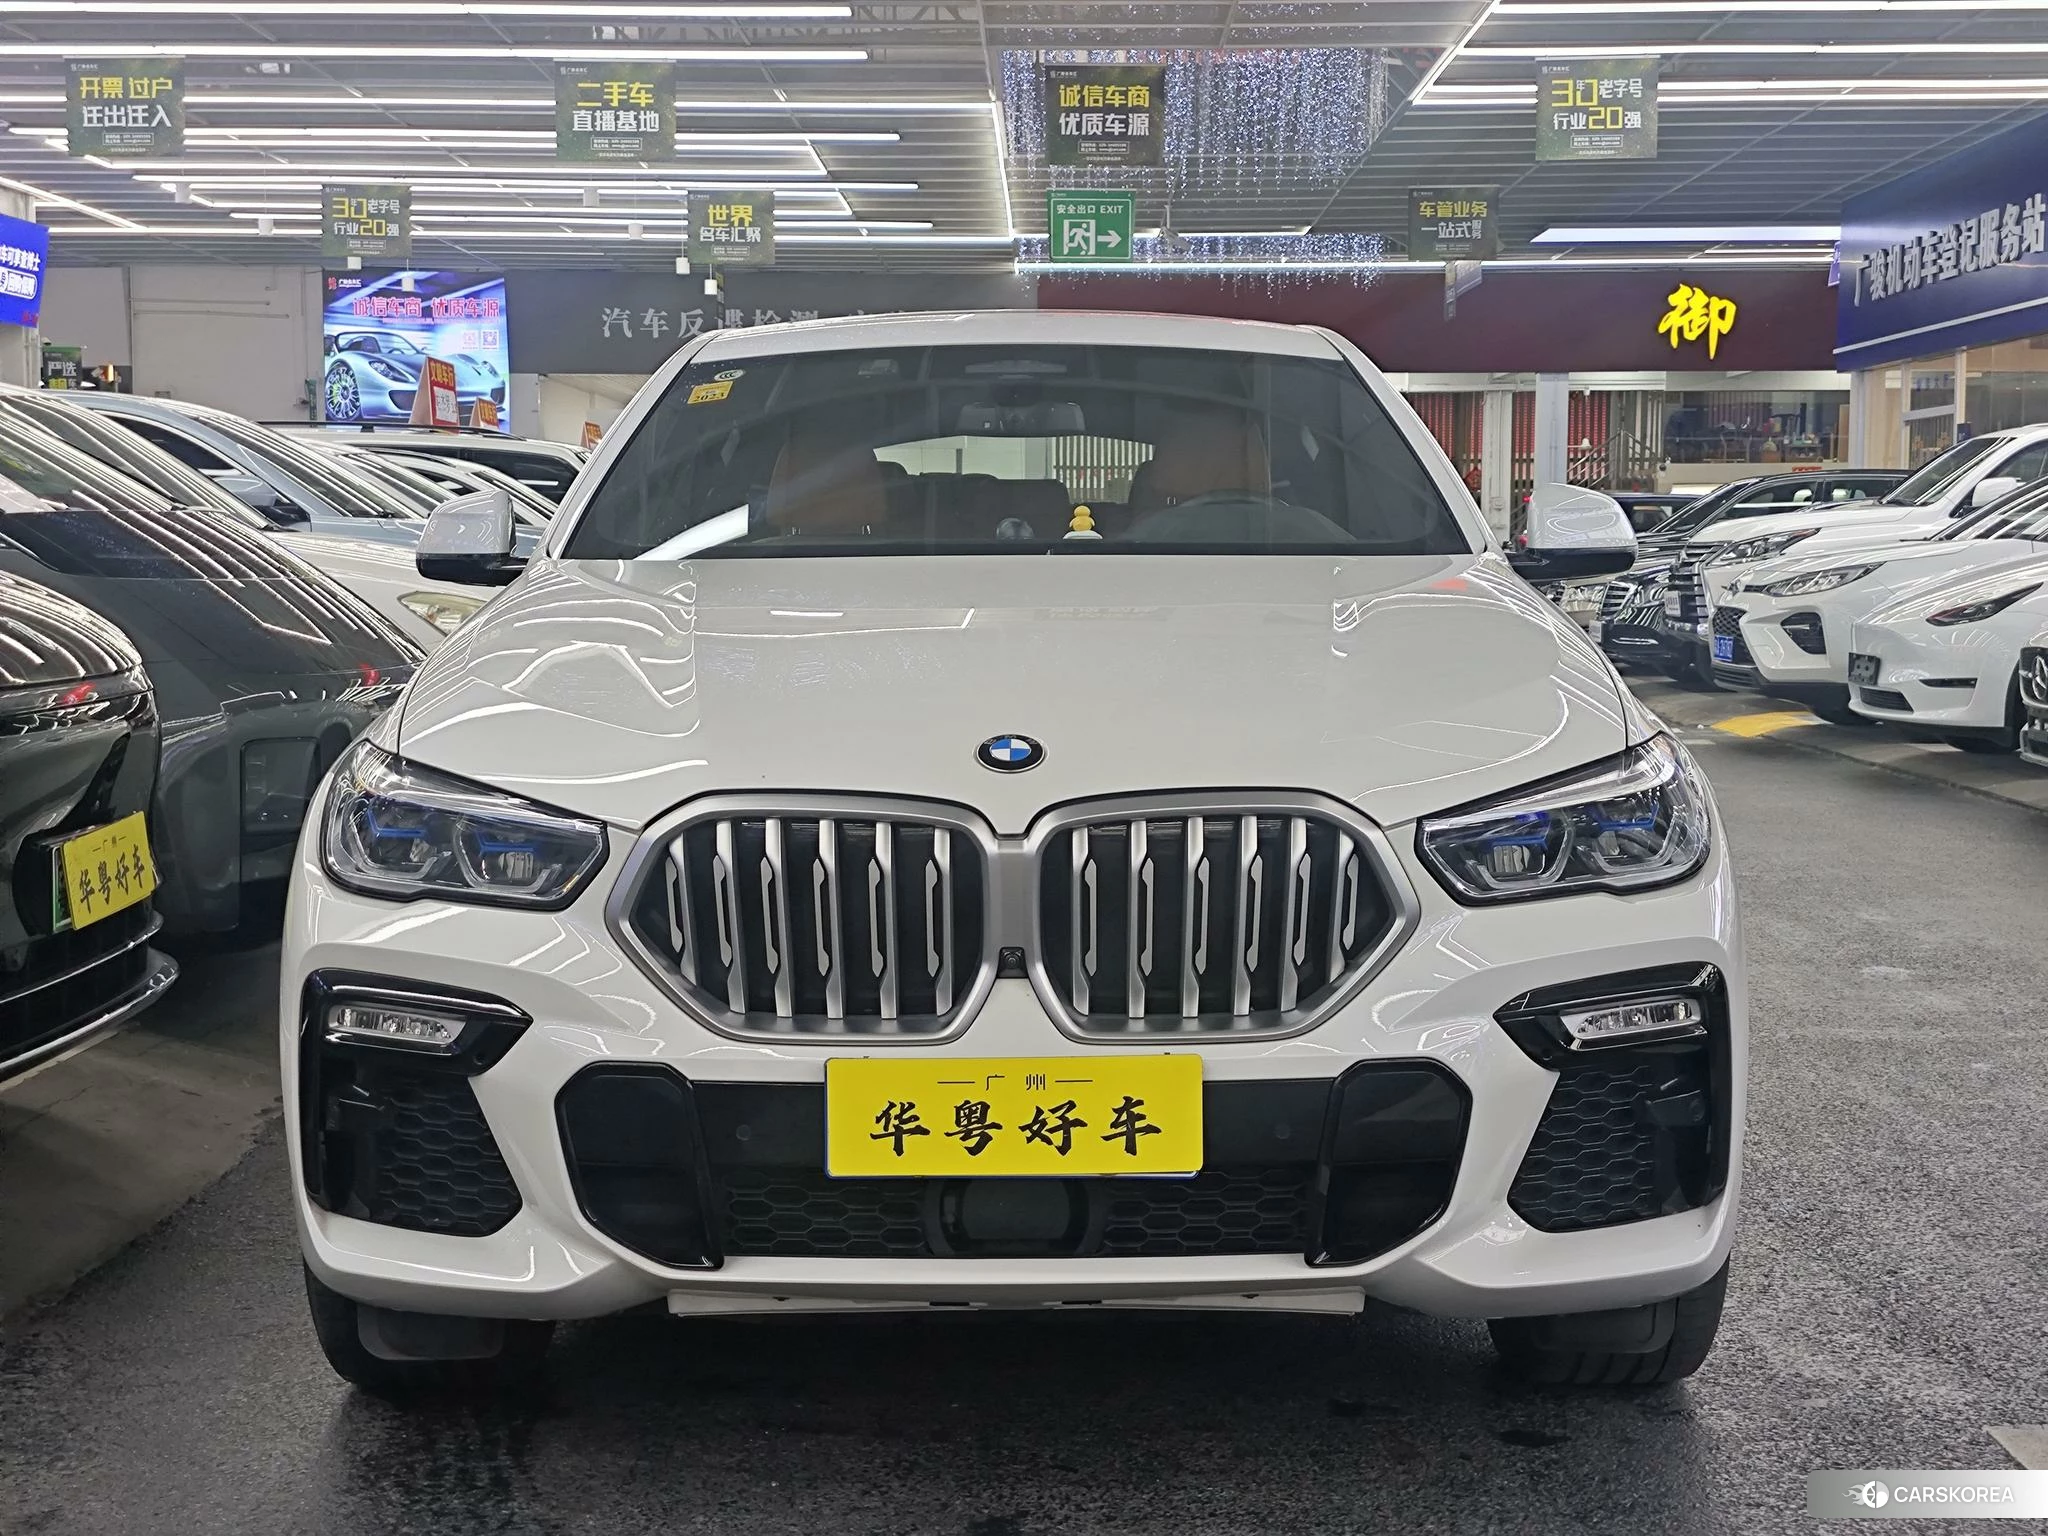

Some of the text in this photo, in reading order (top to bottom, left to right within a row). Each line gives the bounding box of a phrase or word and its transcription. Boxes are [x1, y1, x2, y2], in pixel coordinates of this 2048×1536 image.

[80, 77, 173, 99] 开票 过户
[576, 81, 654, 107] 二手车
[1059, 84, 1150, 108] 诚信车商
[82, 104, 172, 127] 迁出迁入
[572, 109, 660, 132] 直播基地
[1059, 112, 1150, 136] 优质车源
[1552, 106, 1642, 130] 行业20强
[708, 204, 753, 227] 世界
[1056, 204, 1124, 214] 安全出口 EXIT
[1419, 201, 1488, 218] 车管业务
[334, 219, 400, 237] 行业20强
[700, 226, 761, 242] 名车汇聚
[1854, 193, 2046, 308] 广骏机动车登记服务站
[353, 297, 499, 318] 诚信车商 优质车源
[1658, 283, 1737, 361] 御
[79, 843, 145, 914] 华粤好车
[985, 1073, 1047, 1091] 广州
[869, 1095, 1162, 1157] 华粤好车
